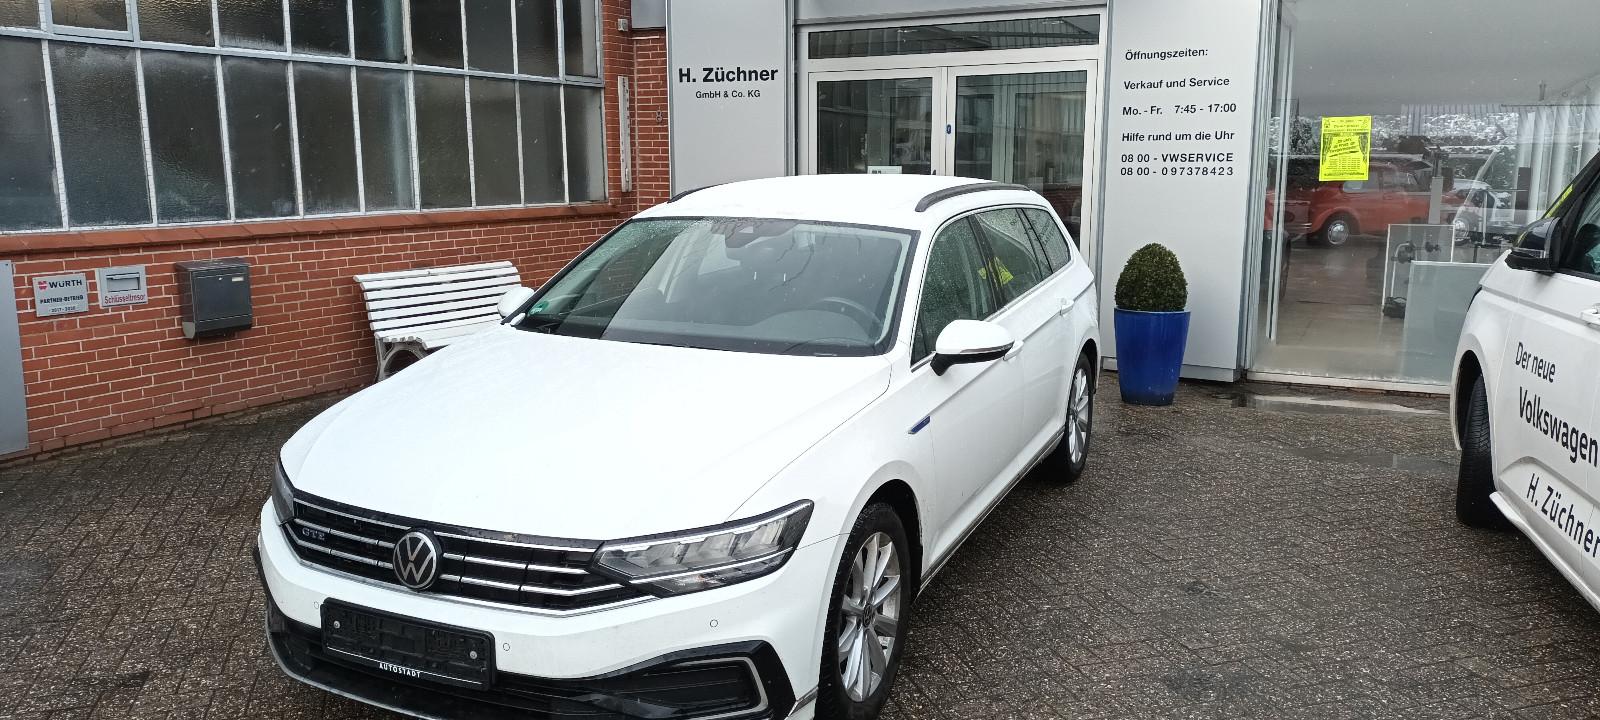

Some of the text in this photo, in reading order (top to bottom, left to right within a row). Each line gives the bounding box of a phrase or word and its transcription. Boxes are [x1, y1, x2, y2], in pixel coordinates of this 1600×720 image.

[1125, 48, 1208, 60] Öffnungszeiten:
[678, 66, 778, 83] H. Züchner
[1123, 77, 1230, 90] Verkauf und Service
[695, 89, 761, 99] GmbH & Co. KG
[1174, 104, 1197, 114] 7:45
[1207, 103, 1237, 113] 17:00
[1121, 132, 1145, 142] Hilfe
[1148, 131, 1172, 141] rund
[1194, 131, 1212, 141] die
[1214, 130, 1235, 140] Uhr
[1121, 153, 1134, 163] 08
[1136, 153, 1150, 163] 00
[1161, 152, 1234, 163] VWSERVICE
[1120, 166, 1133, 176] 08
[1136, 166, 1150, 176] 00
[48, 279, 83, 289] WÜRTH
[104, 293, 146, 305] Schlüsseltresor
[1515, 341, 1556, 383] Der neue
[1519, 386, 1599, 468] Volkswagen
[1526, 472, 1600, 559] H. Züchner
[302, 527, 325, 541] GTE
[379, 663, 421, 679] AUTOSTADT
